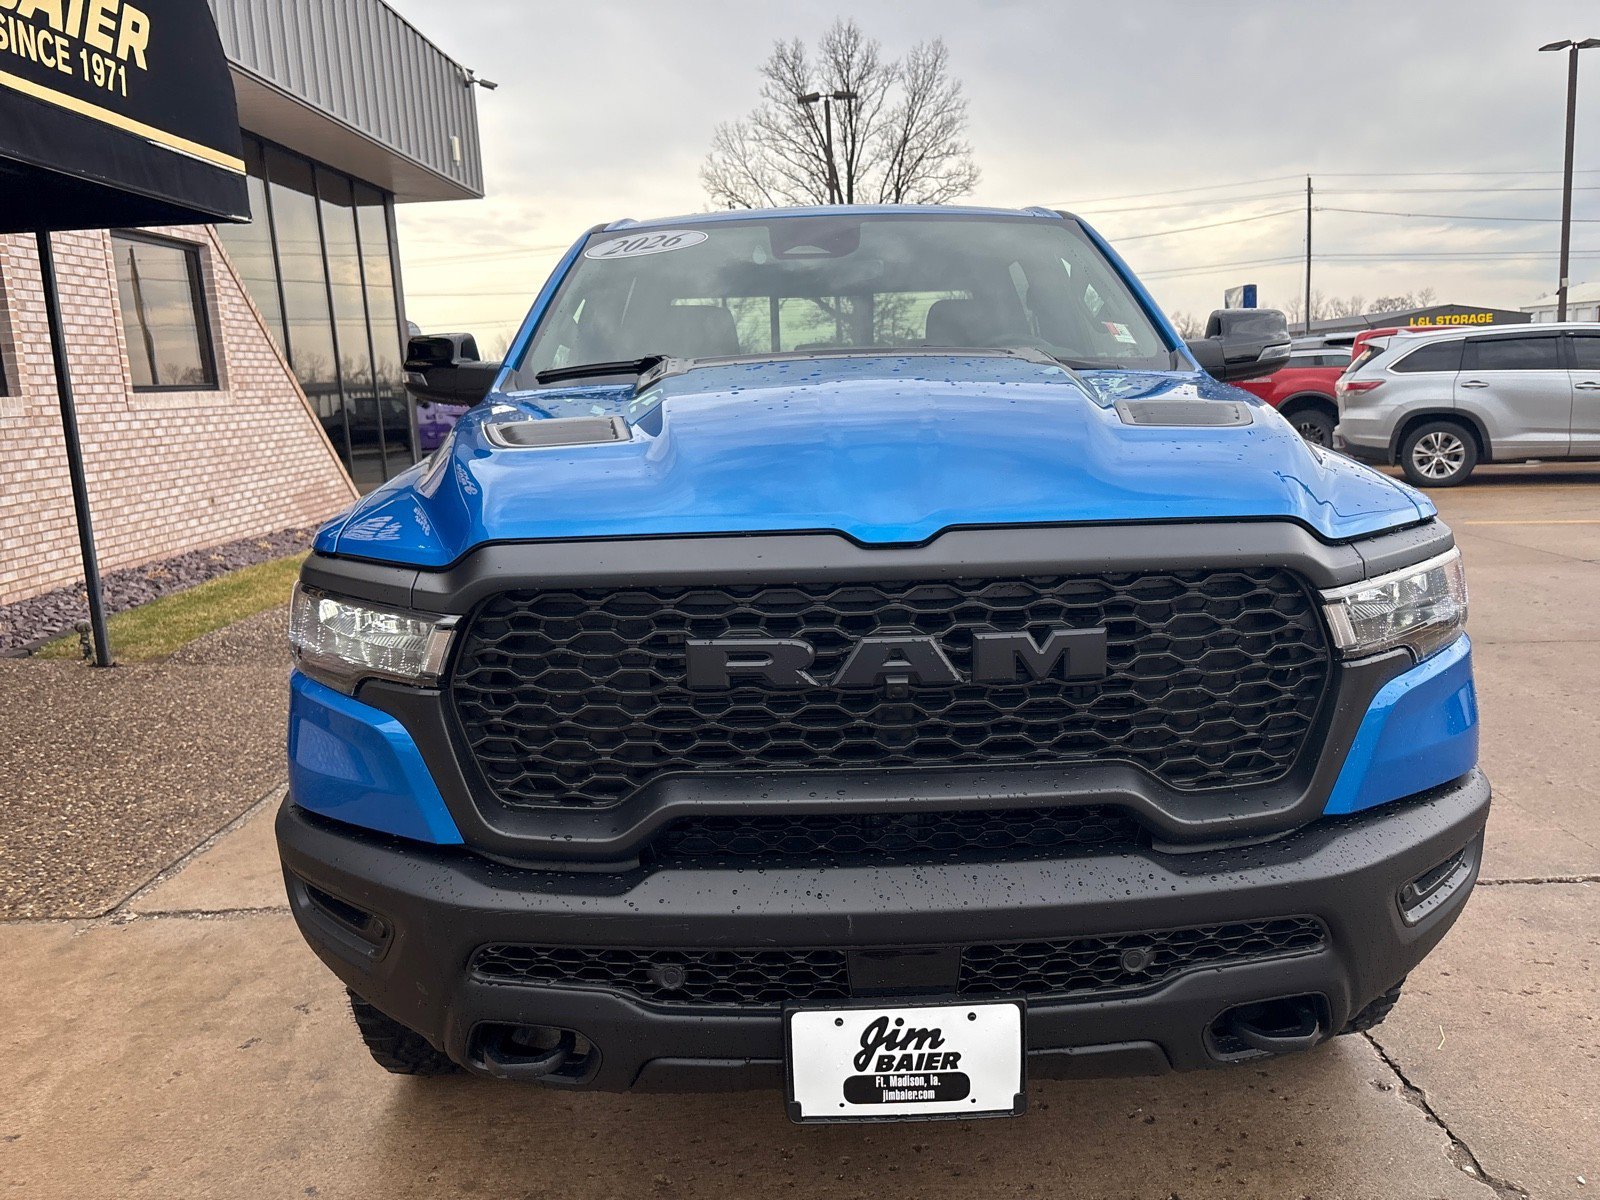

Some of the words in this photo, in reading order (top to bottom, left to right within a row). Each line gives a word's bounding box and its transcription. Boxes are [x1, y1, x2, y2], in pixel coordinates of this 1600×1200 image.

[80, 48, 127, 97] 1971
[601, 232, 692, 256] 2026
[1409, 317, 1433, 327] L&L
[1436, 312, 1494, 325] STORAGE
[685, 627, 1108, 689] RAM
[853, 1016, 946, 1073] Jim
[874, 1051, 962, 1073] BAIER
[875, 1076, 887, 1088] Ft.
[889, 1075, 928, 1088] Madison,
[882, 1089, 936, 1102] jimbaier.com
